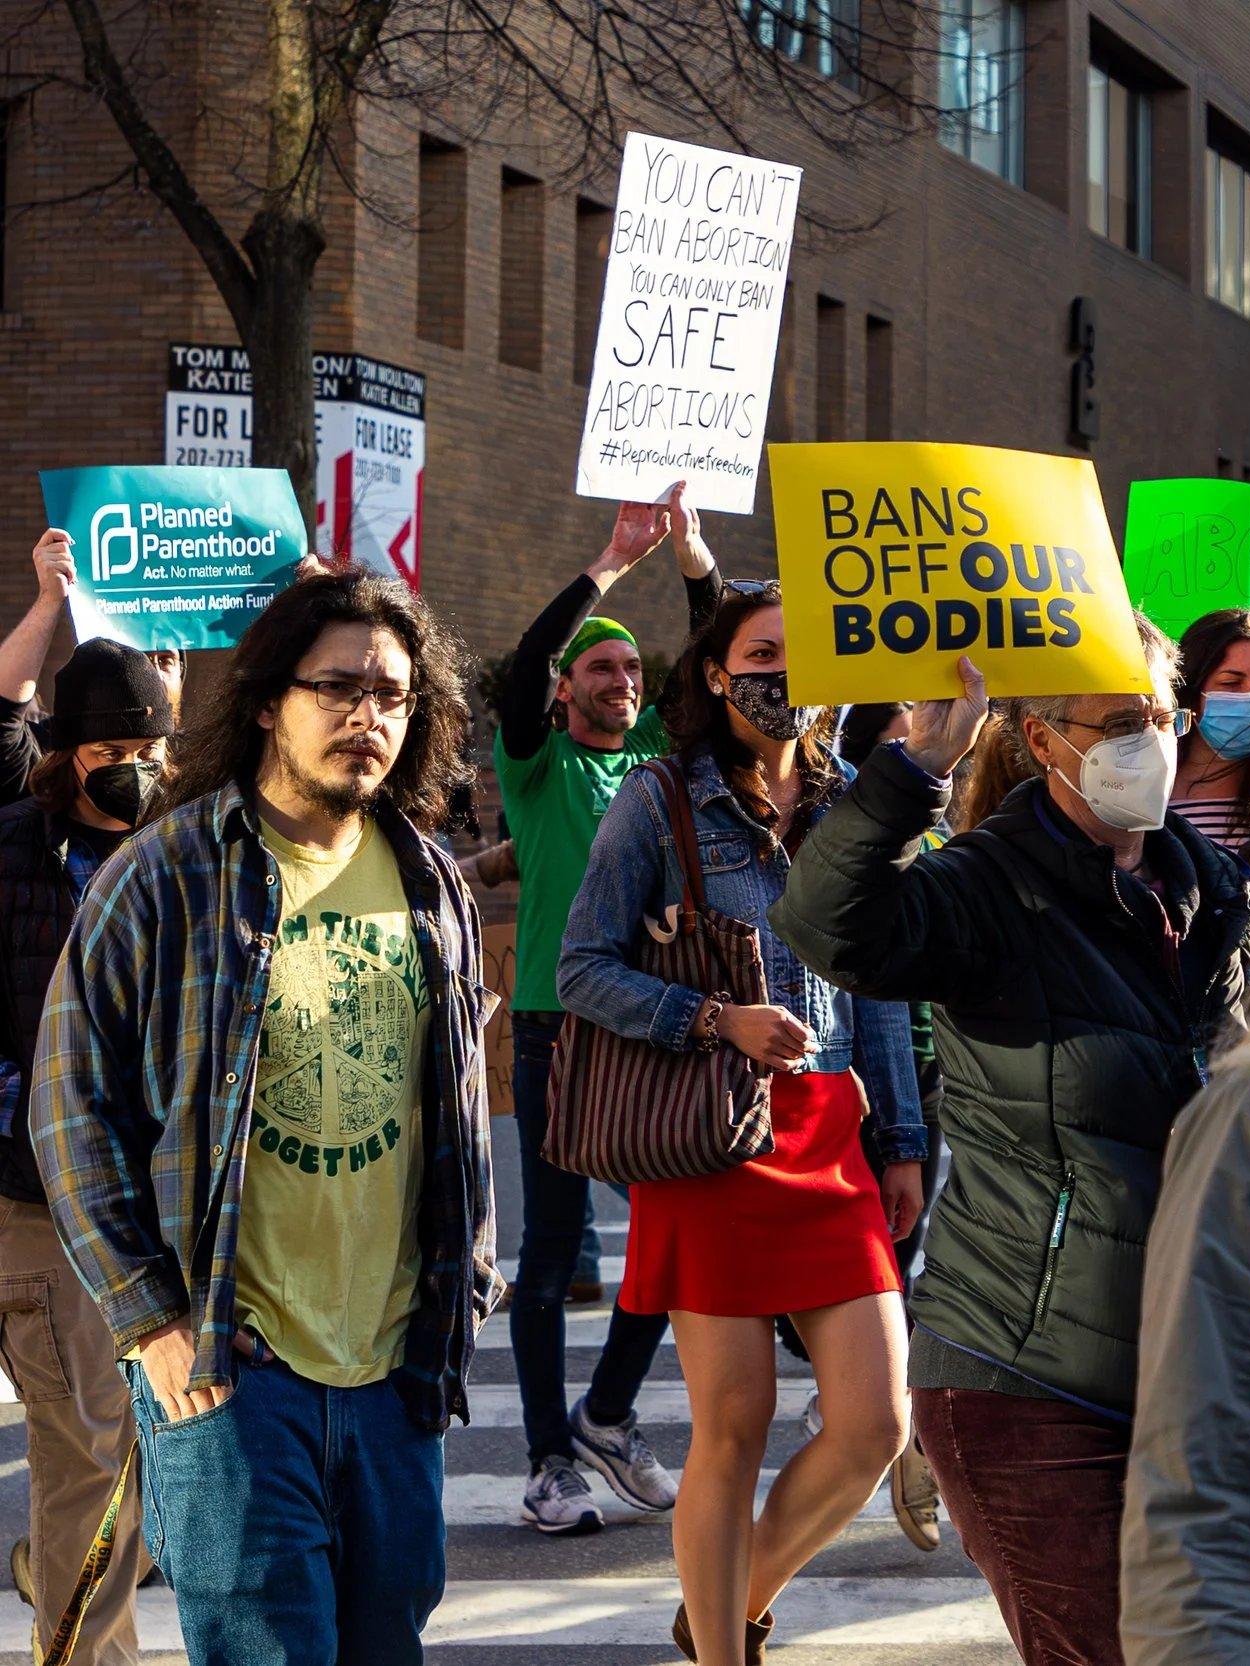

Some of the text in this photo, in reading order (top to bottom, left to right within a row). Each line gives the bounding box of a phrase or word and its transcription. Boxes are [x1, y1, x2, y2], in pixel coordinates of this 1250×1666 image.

[644, 142, 795, 226] YOU CAN'T
[615, 210, 788, 272] BAN ABORTION
[630, 264, 773, 310] YOU CAN ONLY BAN
[172, 347, 223, 370] TOM
[613, 300, 738, 372] SAFE
[187, 369, 253, 393] KATIE
[361, 381, 388, 406] KATIE
[177, 405, 228, 440] FOR
[591, 380, 757, 439] ABORTIONS
[355, 416, 376, 451] FOR
[380, 421, 412, 459] LEASE
[141, 501, 233, 529] Planned
[822, 486, 989, 540] BANS
[143, 564, 254, 580] Act. No matter what.
[824, 541, 1095, 599] OFF OUR
[96, 599, 140, 615] Planned
[143, 596, 205, 613] Parenthood
[208, 594, 243, 611] Action
[833, 597, 1082, 656] BODIES
[320, 911, 404, 967] THIS
[250, 1109, 401, 1178] TOGETHER
